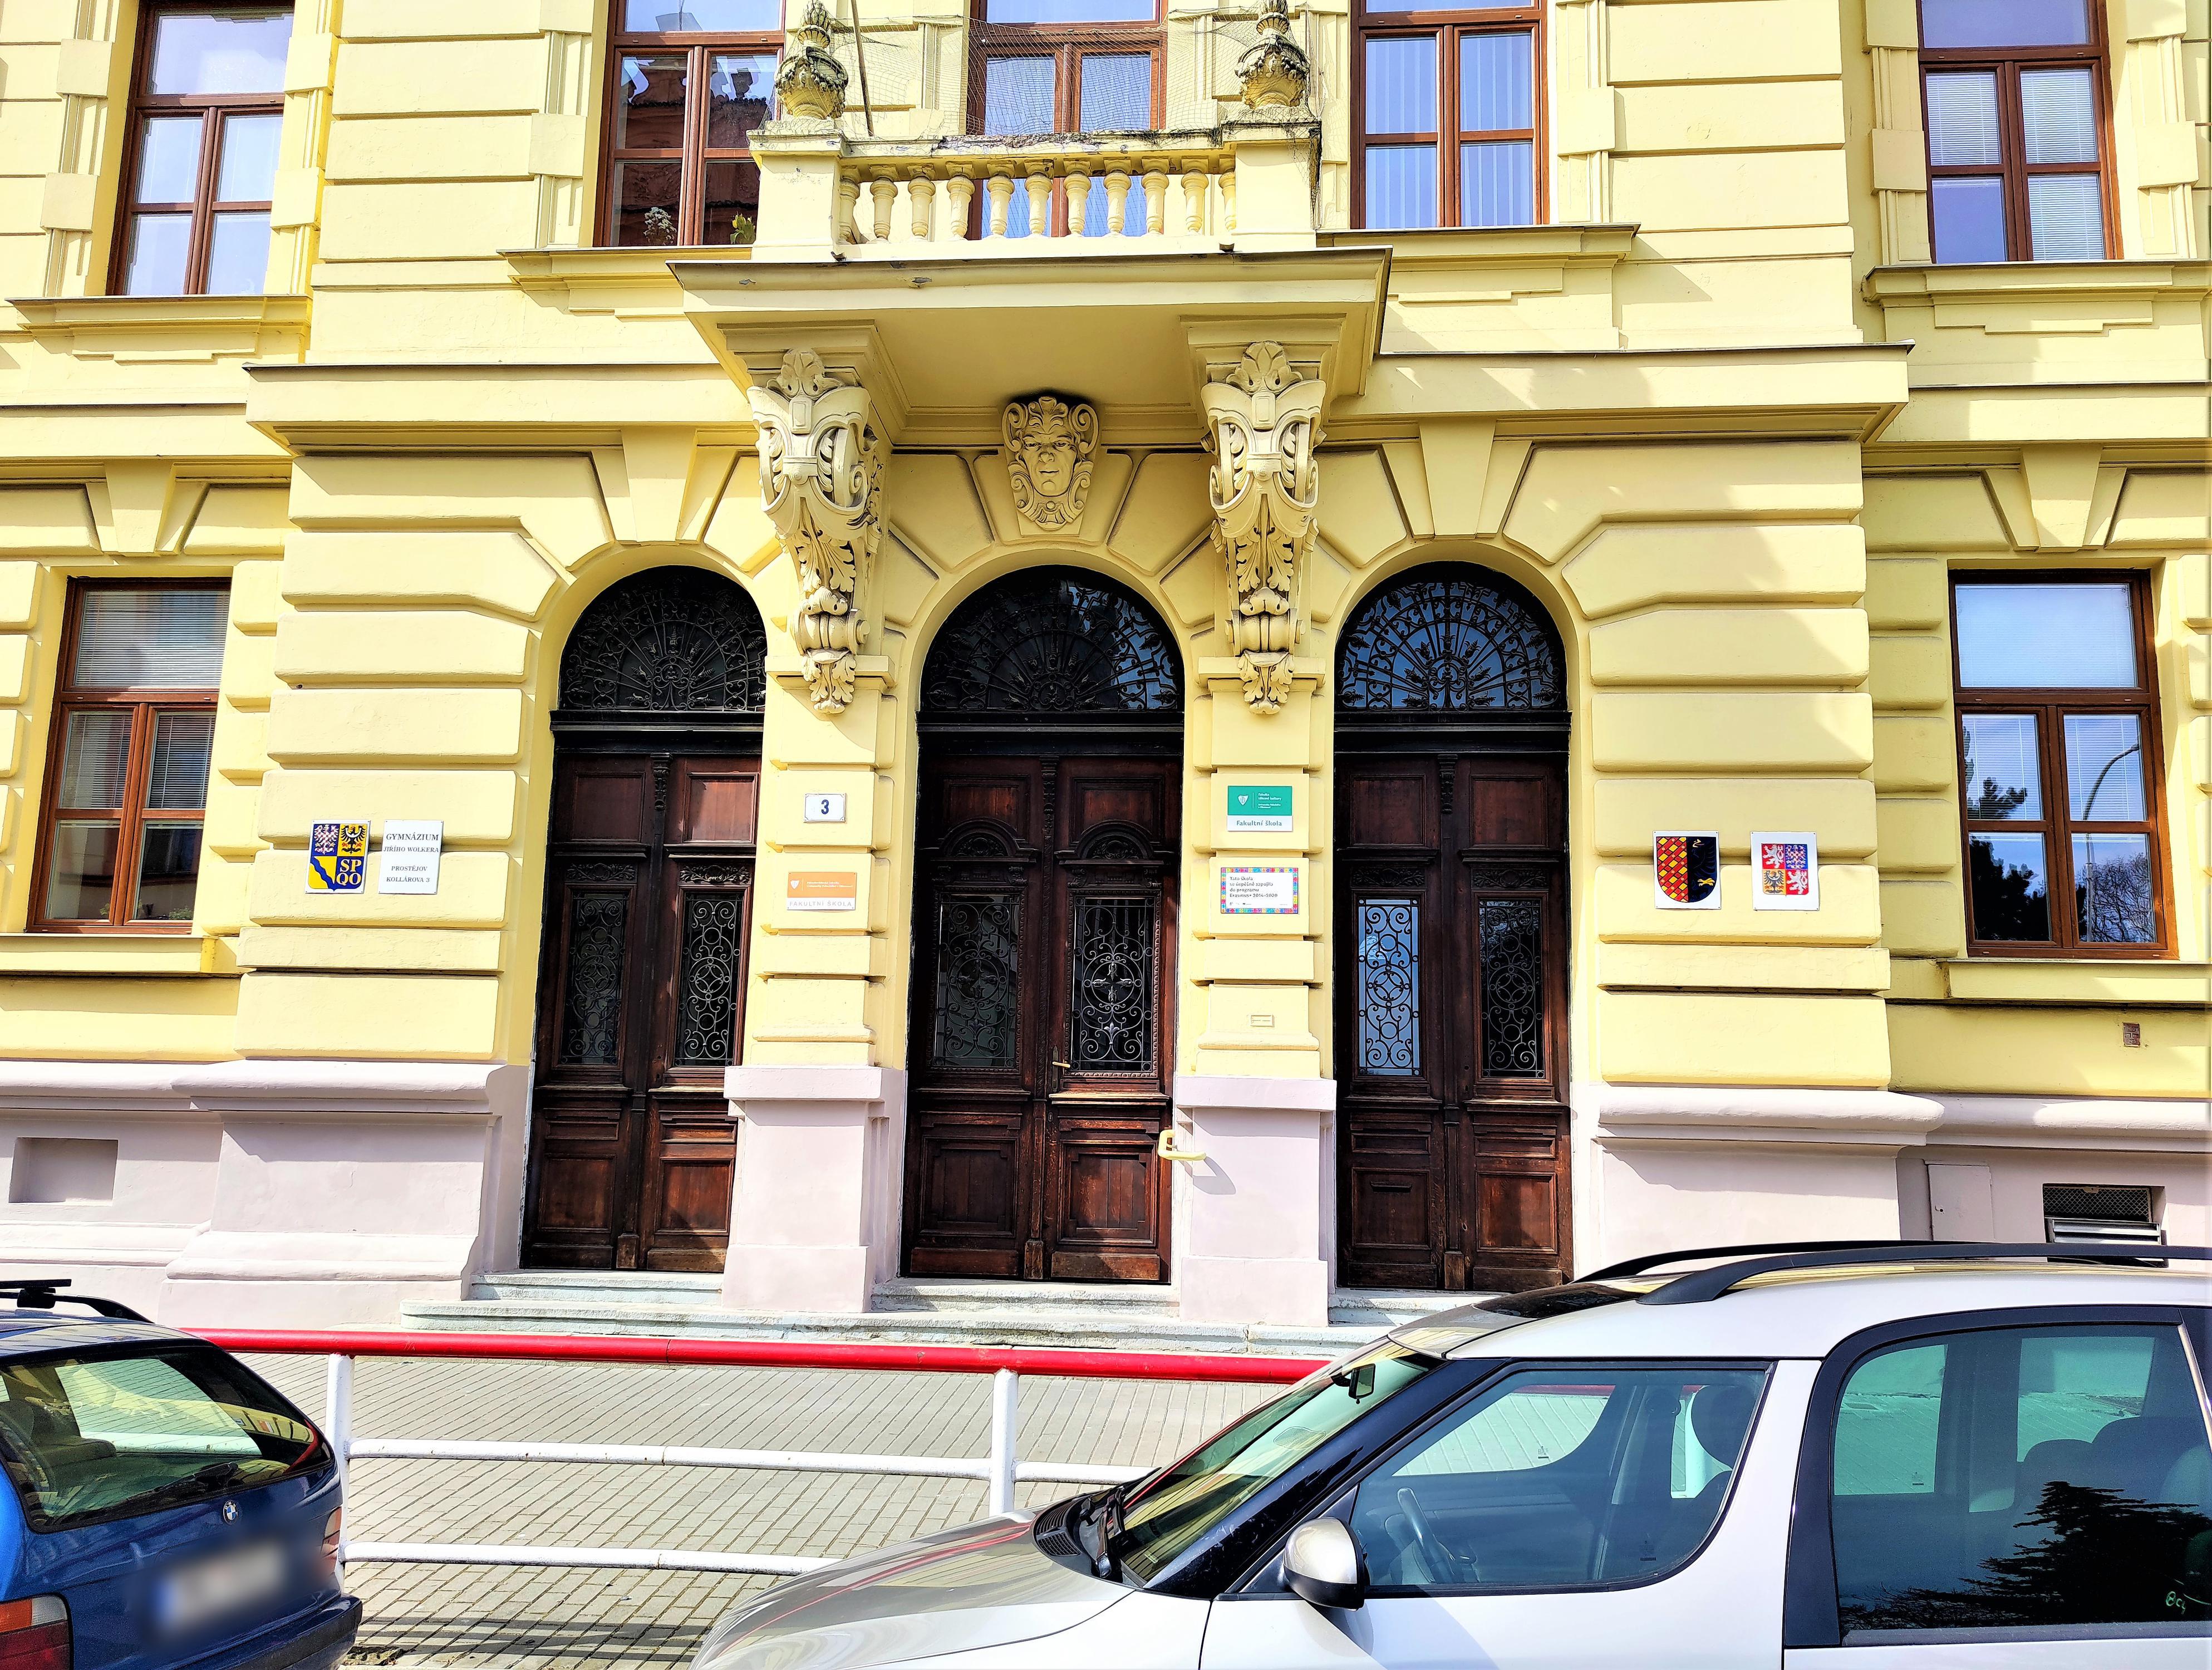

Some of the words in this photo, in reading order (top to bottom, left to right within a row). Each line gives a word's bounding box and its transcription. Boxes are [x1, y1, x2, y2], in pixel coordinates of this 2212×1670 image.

[821, 799, 829, 814] 3
[386, 832, 439, 841] GYMNÁZIUM
[340, 858, 362, 872] SP
[336, 872, 362, 886] QO
